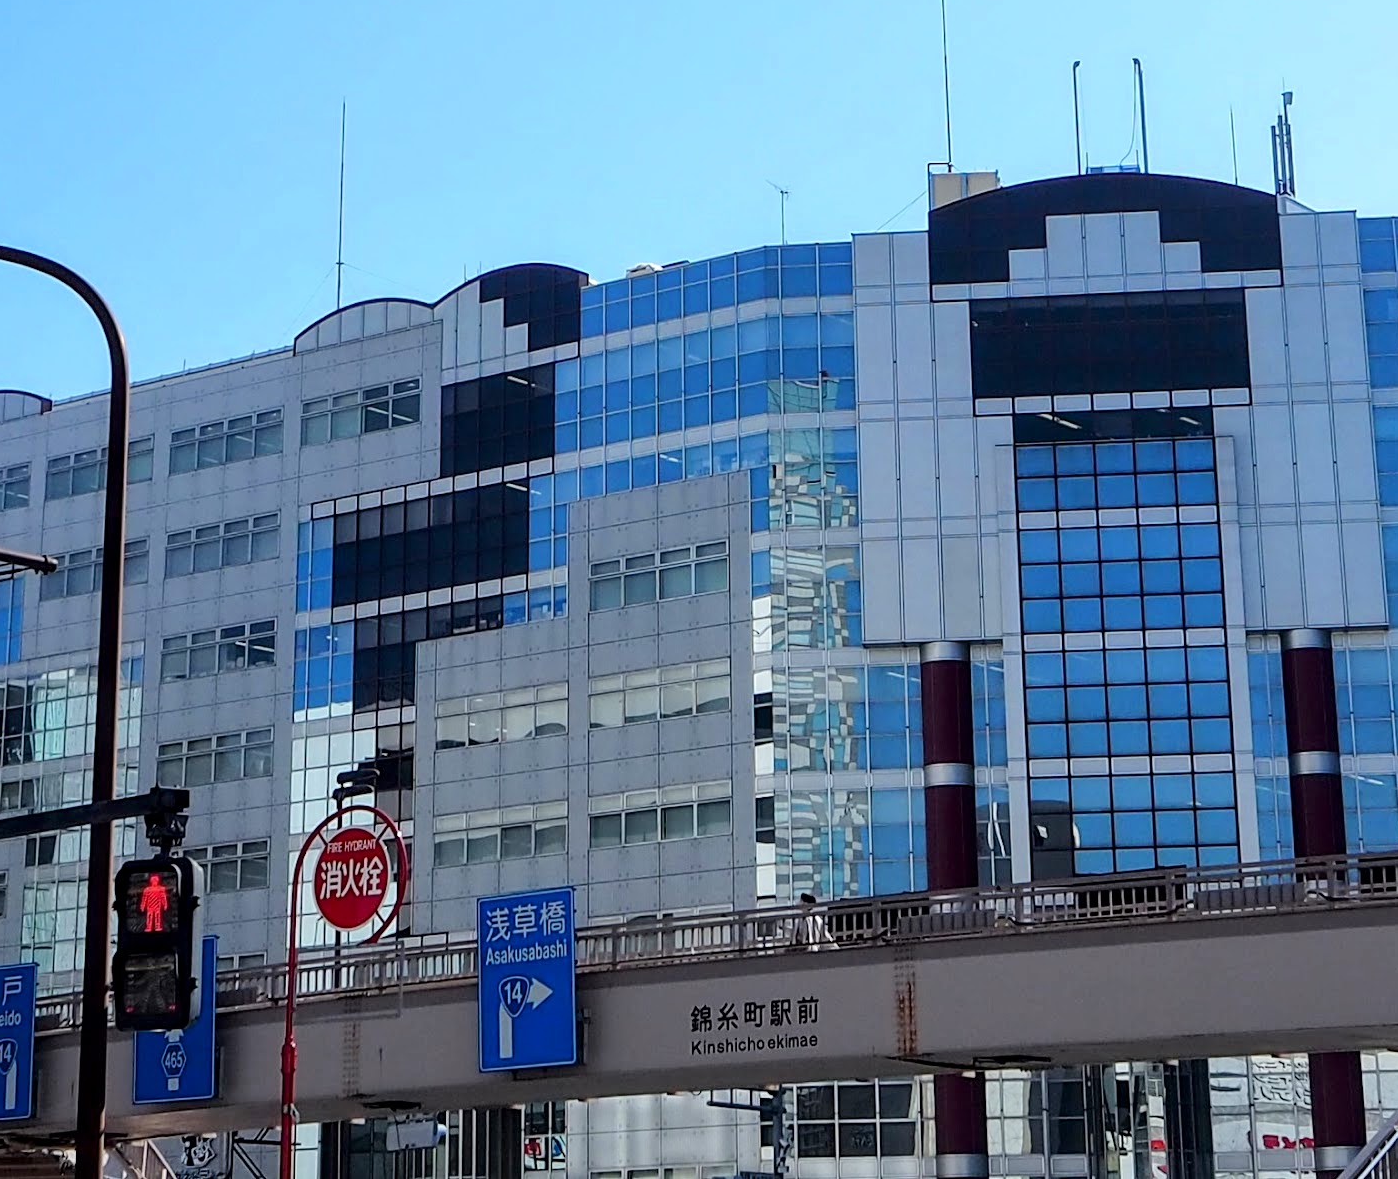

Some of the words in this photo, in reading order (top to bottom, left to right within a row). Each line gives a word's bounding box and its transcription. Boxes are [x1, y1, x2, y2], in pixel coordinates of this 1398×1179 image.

[326, 842, 343, 854] FIRE
[344, 839, 377, 852] HYDRANT
[319, 855, 384, 900] 消火栓
[486, 900, 566, 942] 浅草橋
[485, 938, 568, 966] Asakusabashi
[504, 980, 523, 1005] 14
[690, 995, 820, 1033] 錦糸町駅前
[164, 1051, 183, 1069] 465
